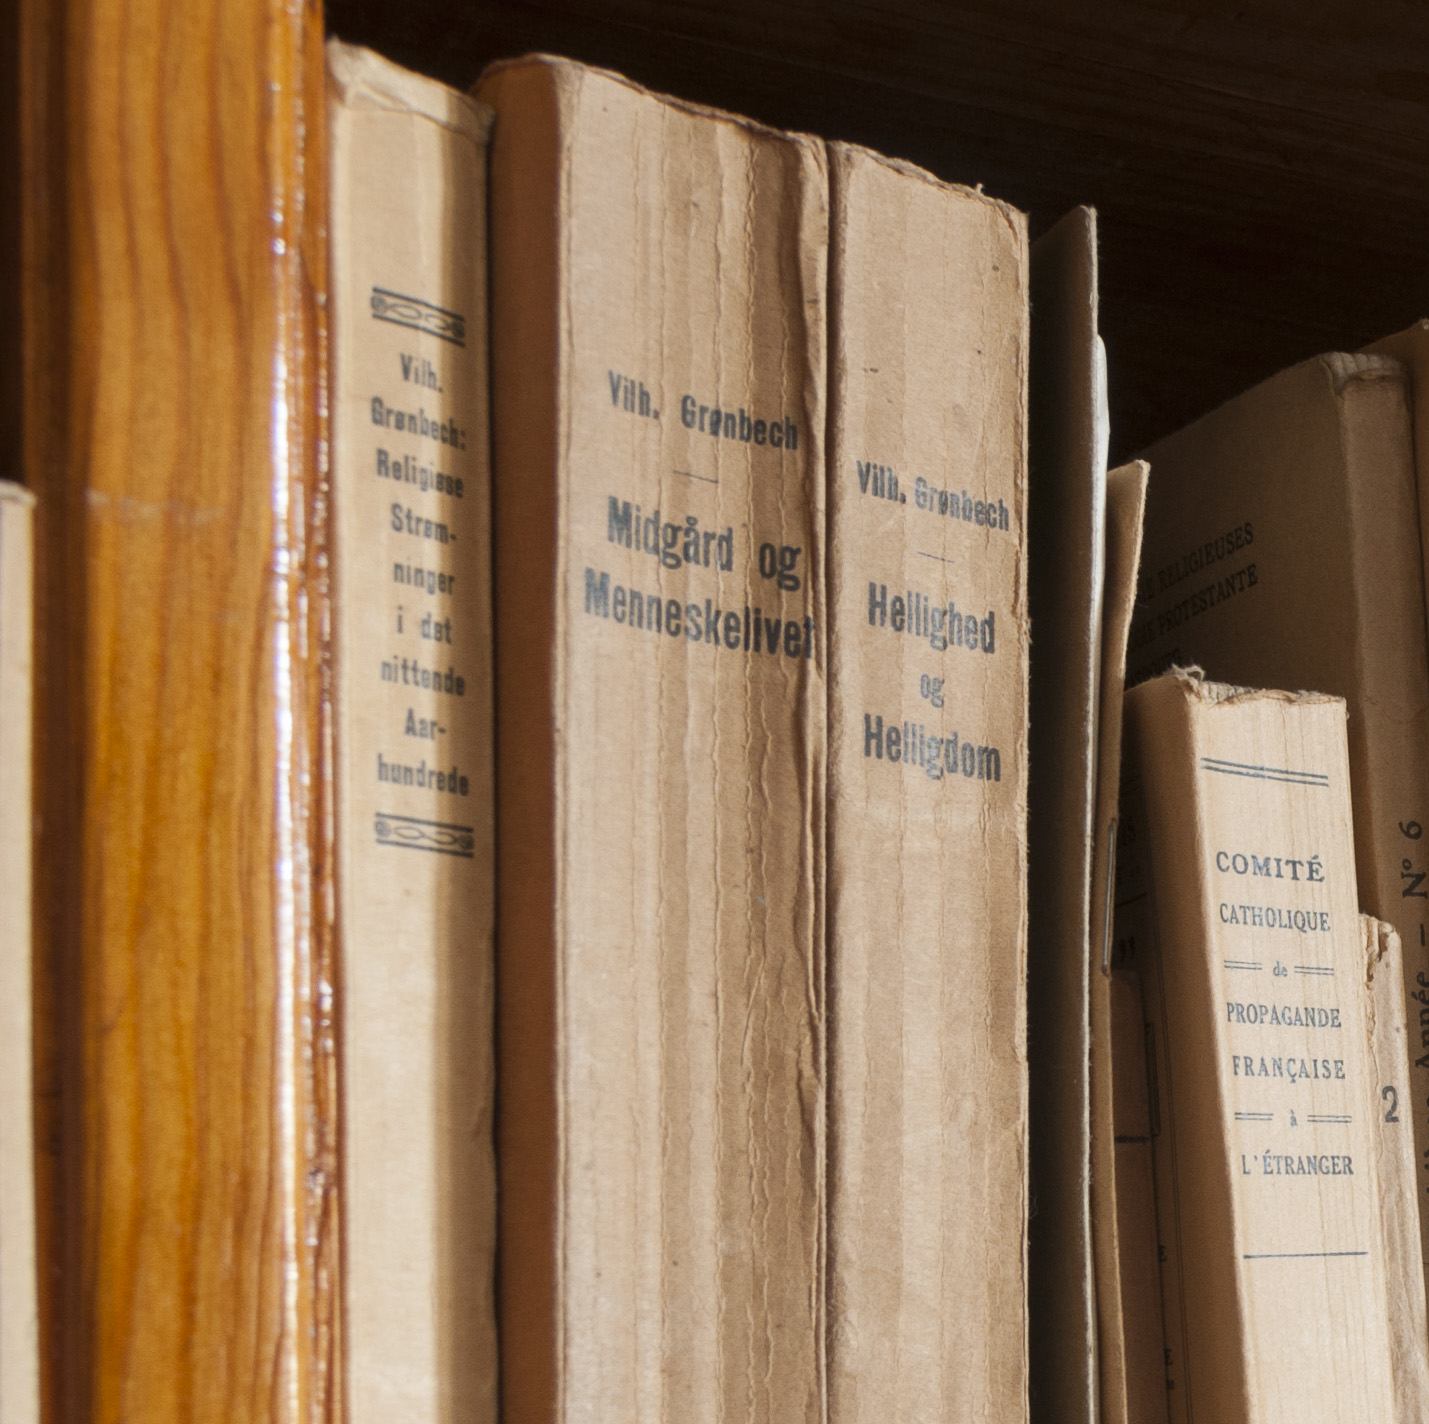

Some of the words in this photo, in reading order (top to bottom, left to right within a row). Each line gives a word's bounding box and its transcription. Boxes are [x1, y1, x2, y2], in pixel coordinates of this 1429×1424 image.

[400, 352, 444, 393] Vilh.
[370, 397, 467, 450] Grønbech:
[608, 370, 660, 420] Vilh.
[681, 394, 799, 451] Grønbech
[376, 450, 465, 499] Religiøse
[857, 460, 906, 504] Vilh.
[914, 476, 1009, 531] Grønbech
[391, 502, 457, 545] Strøm-
[607, 495, 733, 573] Midgård
[759, 541, 802, 590] og
[393, 559, 455, 597] ninger
[396, 605, 404, 635] i
[421, 612, 452, 646] det
[584, 568, 815, 660] Menneskelivet
[868, 581, 995, 654] Hellighed
[380, 657, 465, 698] nittende
[920, 673, 944, 708] og
[405, 707, 447, 743] Aar-
[864, 713, 1000, 782] Helligdom
[377, 754, 469, 797] hundrede
[1399, 820, 1423, 840] 6
[1216, 851, 1325, 882] COMITÉ
[1219, 903, 1331, 933] CATHOLIQUE
[1273, 960, 1288, 978] de
[1226, 1002, 1342, 1028] PROPAGANDE
[1233, 1056, 1346, 1083] FRANÇAISE
[1289, 1110, 1298, 1127] à
[1381, 1085, 1399, 1123] 2
